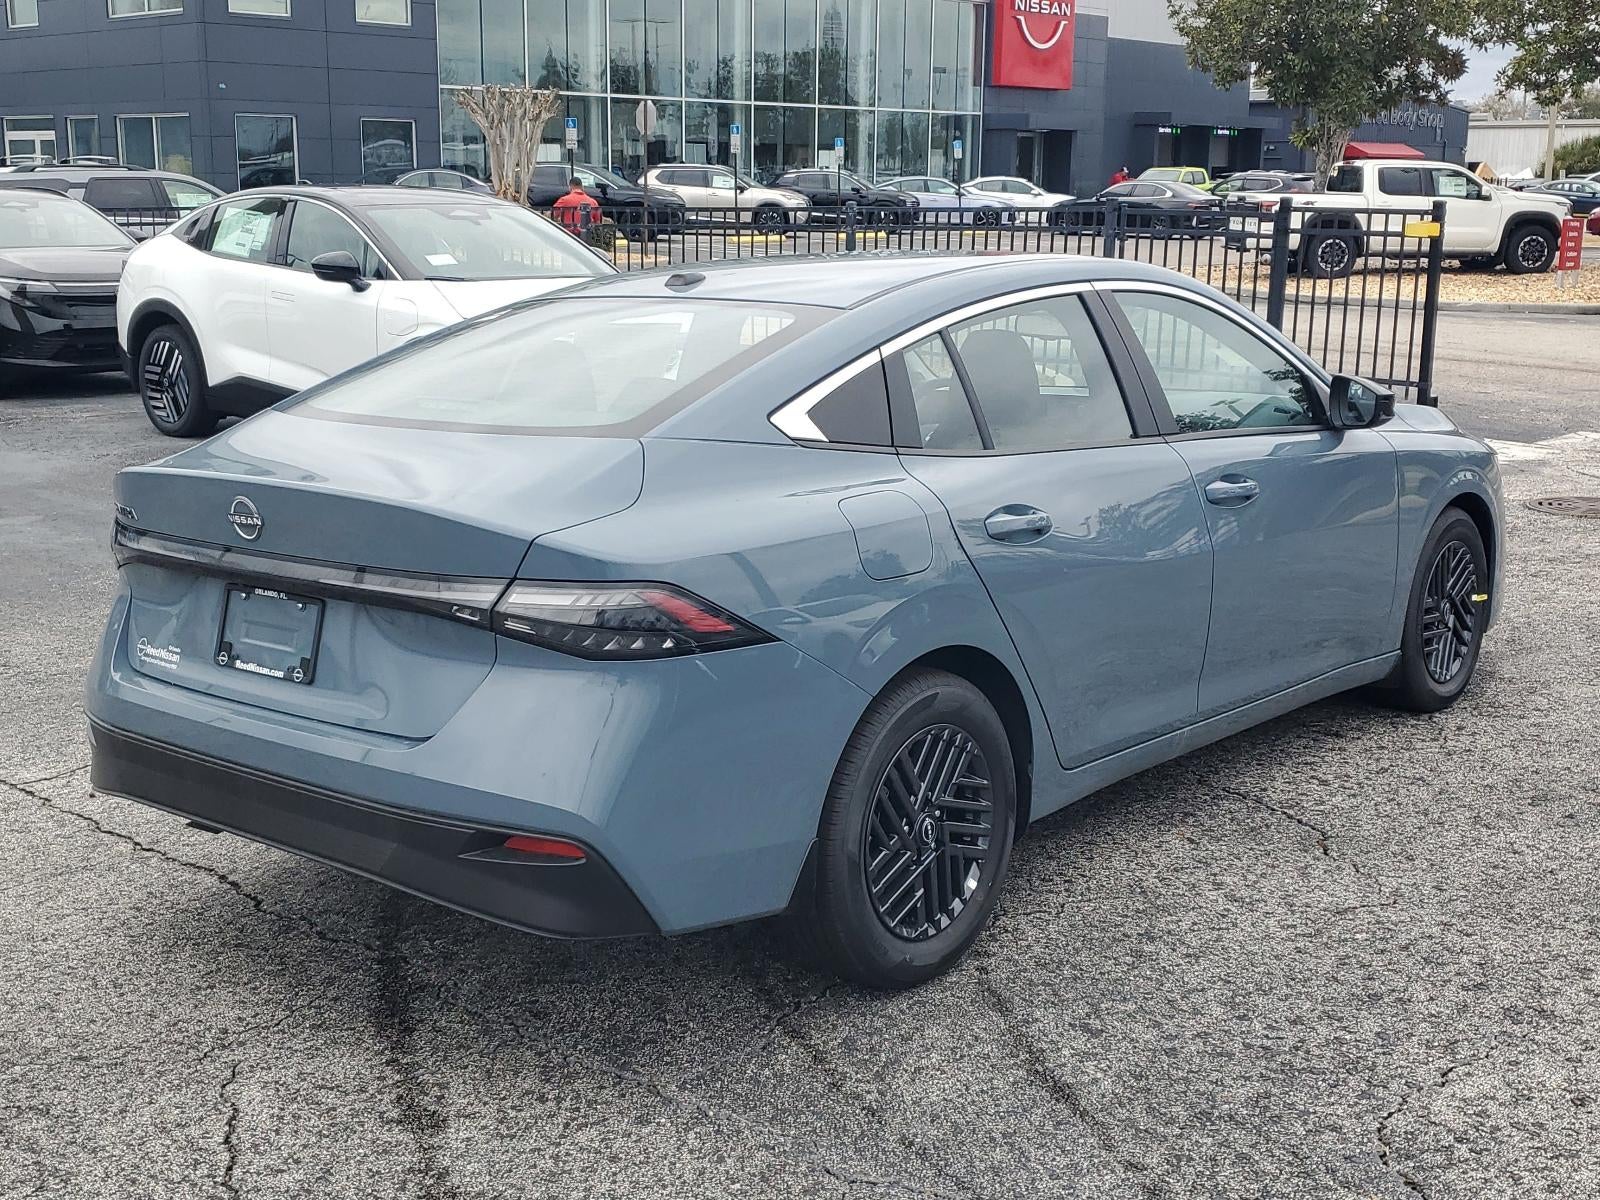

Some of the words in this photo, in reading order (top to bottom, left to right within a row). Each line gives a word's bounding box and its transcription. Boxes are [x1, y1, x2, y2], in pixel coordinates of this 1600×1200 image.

[1015, 0, 1071, 16] NISSAN
[228, 513, 262, 525] NISSAN
[235, 660, 284, 678] ReedNissan.com
